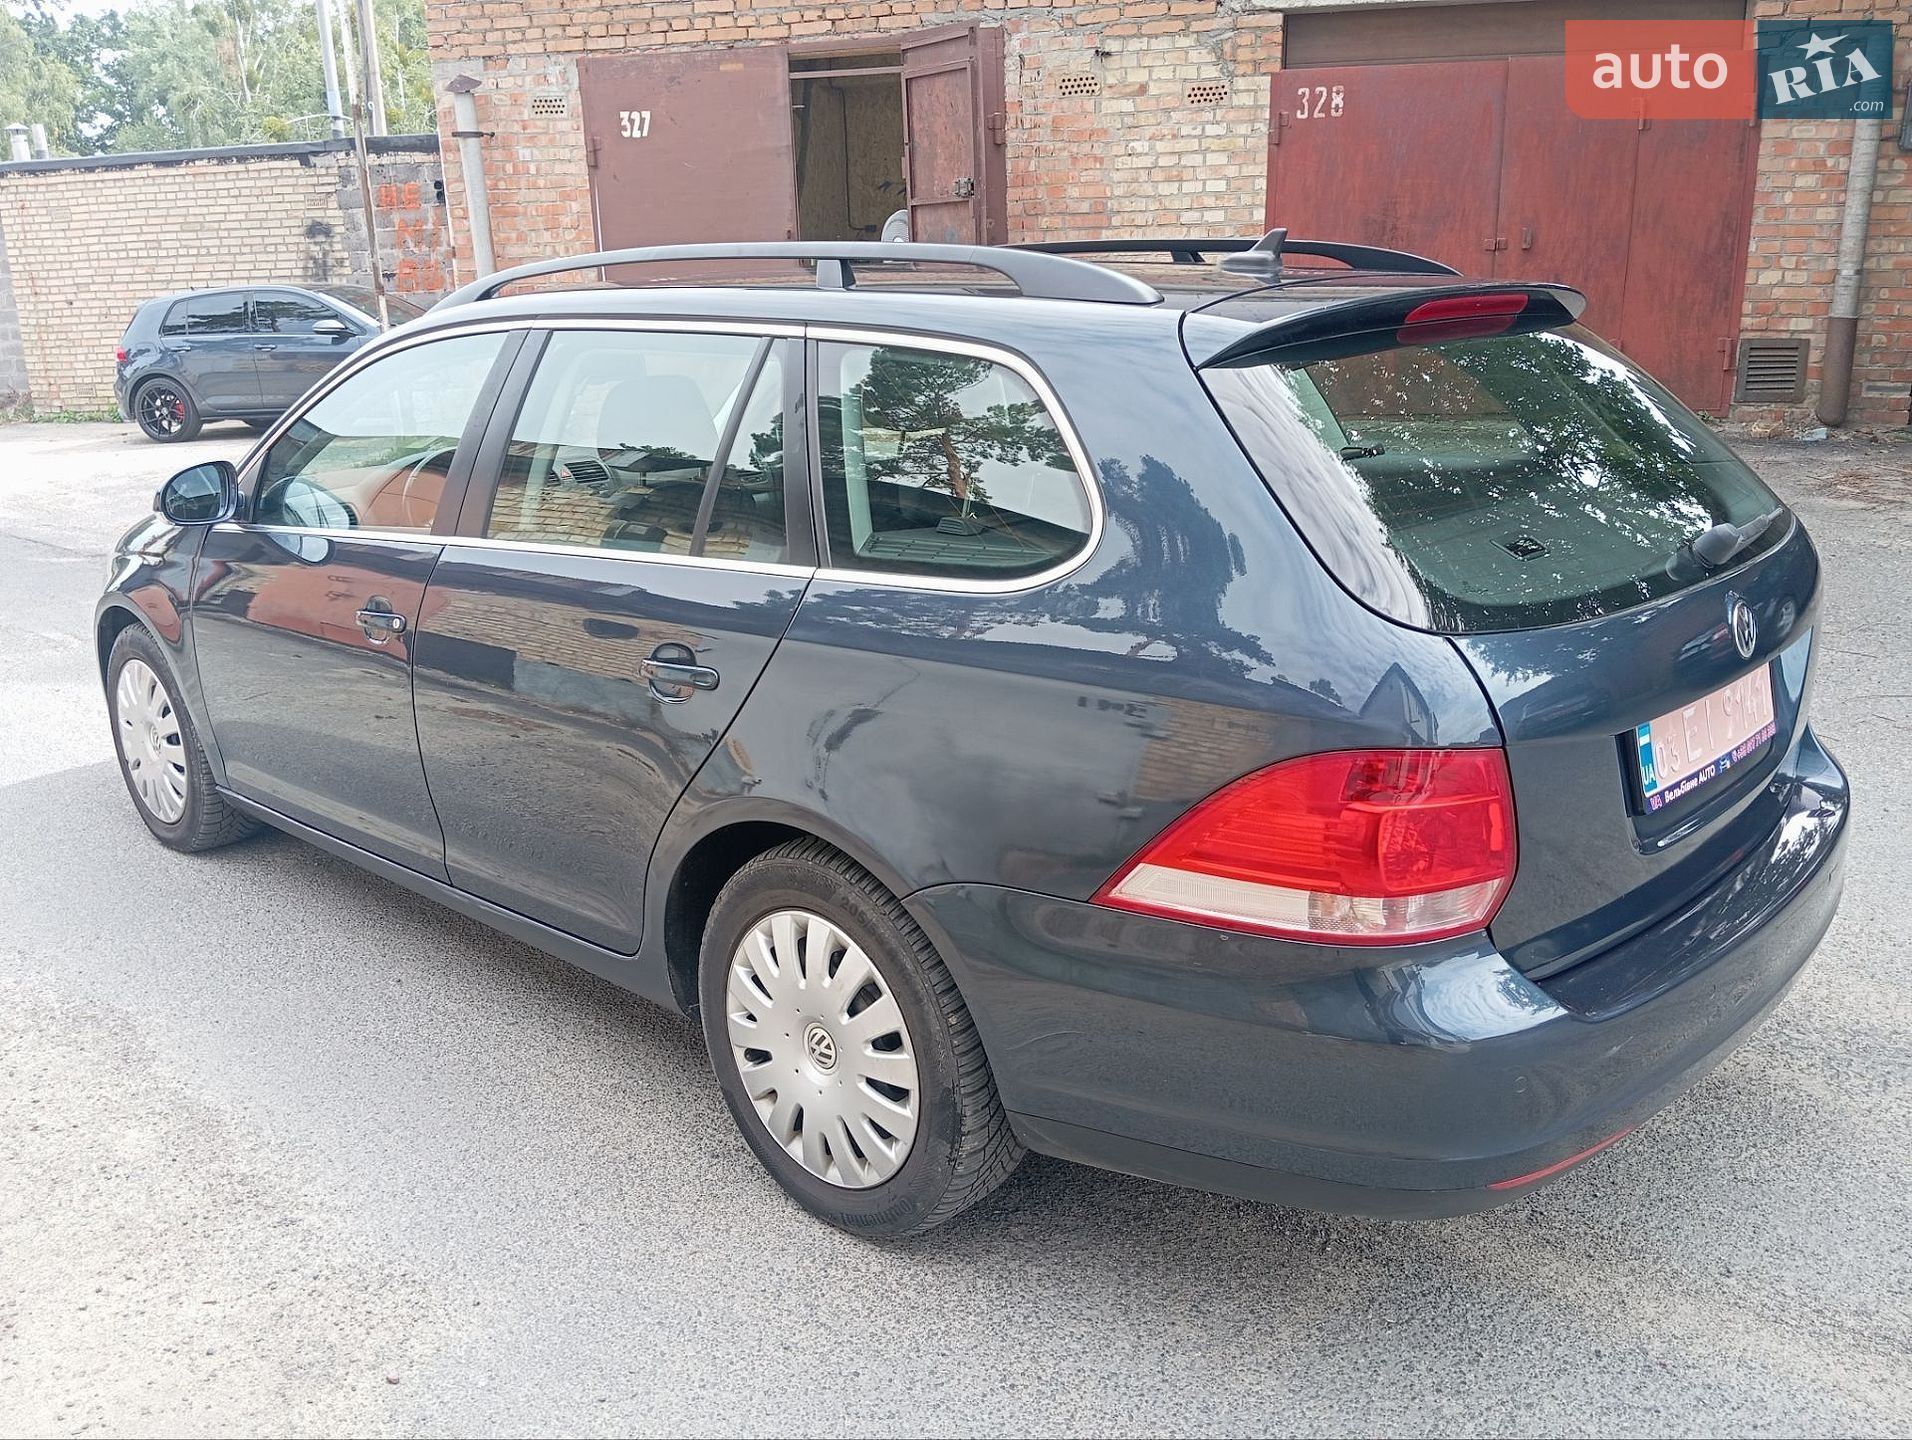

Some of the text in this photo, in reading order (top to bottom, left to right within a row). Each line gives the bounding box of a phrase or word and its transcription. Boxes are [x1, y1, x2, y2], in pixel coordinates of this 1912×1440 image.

[1296, 85, 1345, 119] 328
[619, 111, 651, 138] 327
[1642, 763, 1656, 785] UA
[1698, 764, 1716, 785] AUTO
